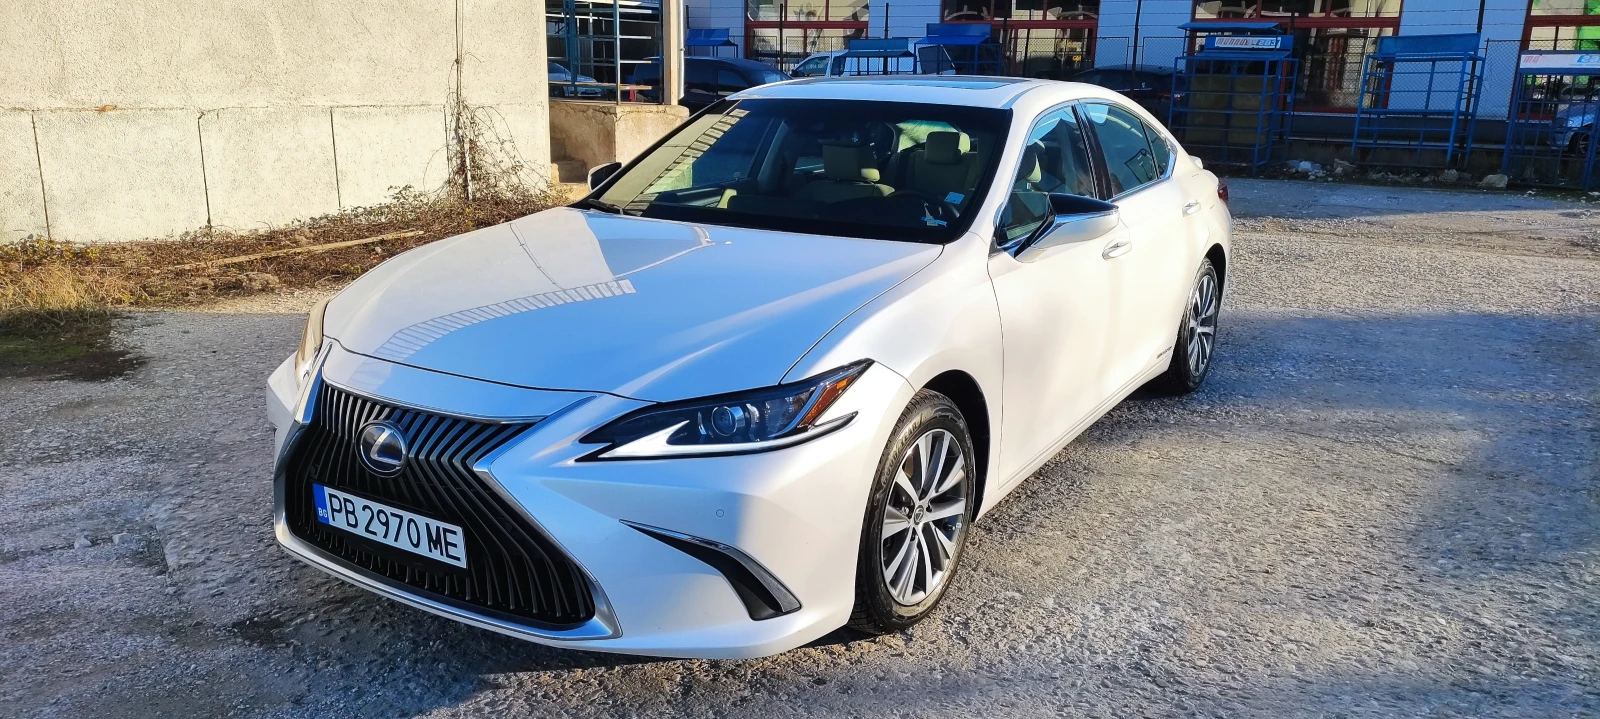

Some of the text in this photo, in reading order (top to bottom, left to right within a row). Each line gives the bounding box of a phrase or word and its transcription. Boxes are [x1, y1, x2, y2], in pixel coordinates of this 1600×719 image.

[318, 507, 328, 518] BG
[328, 492, 461, 562] PB 2970 ME
